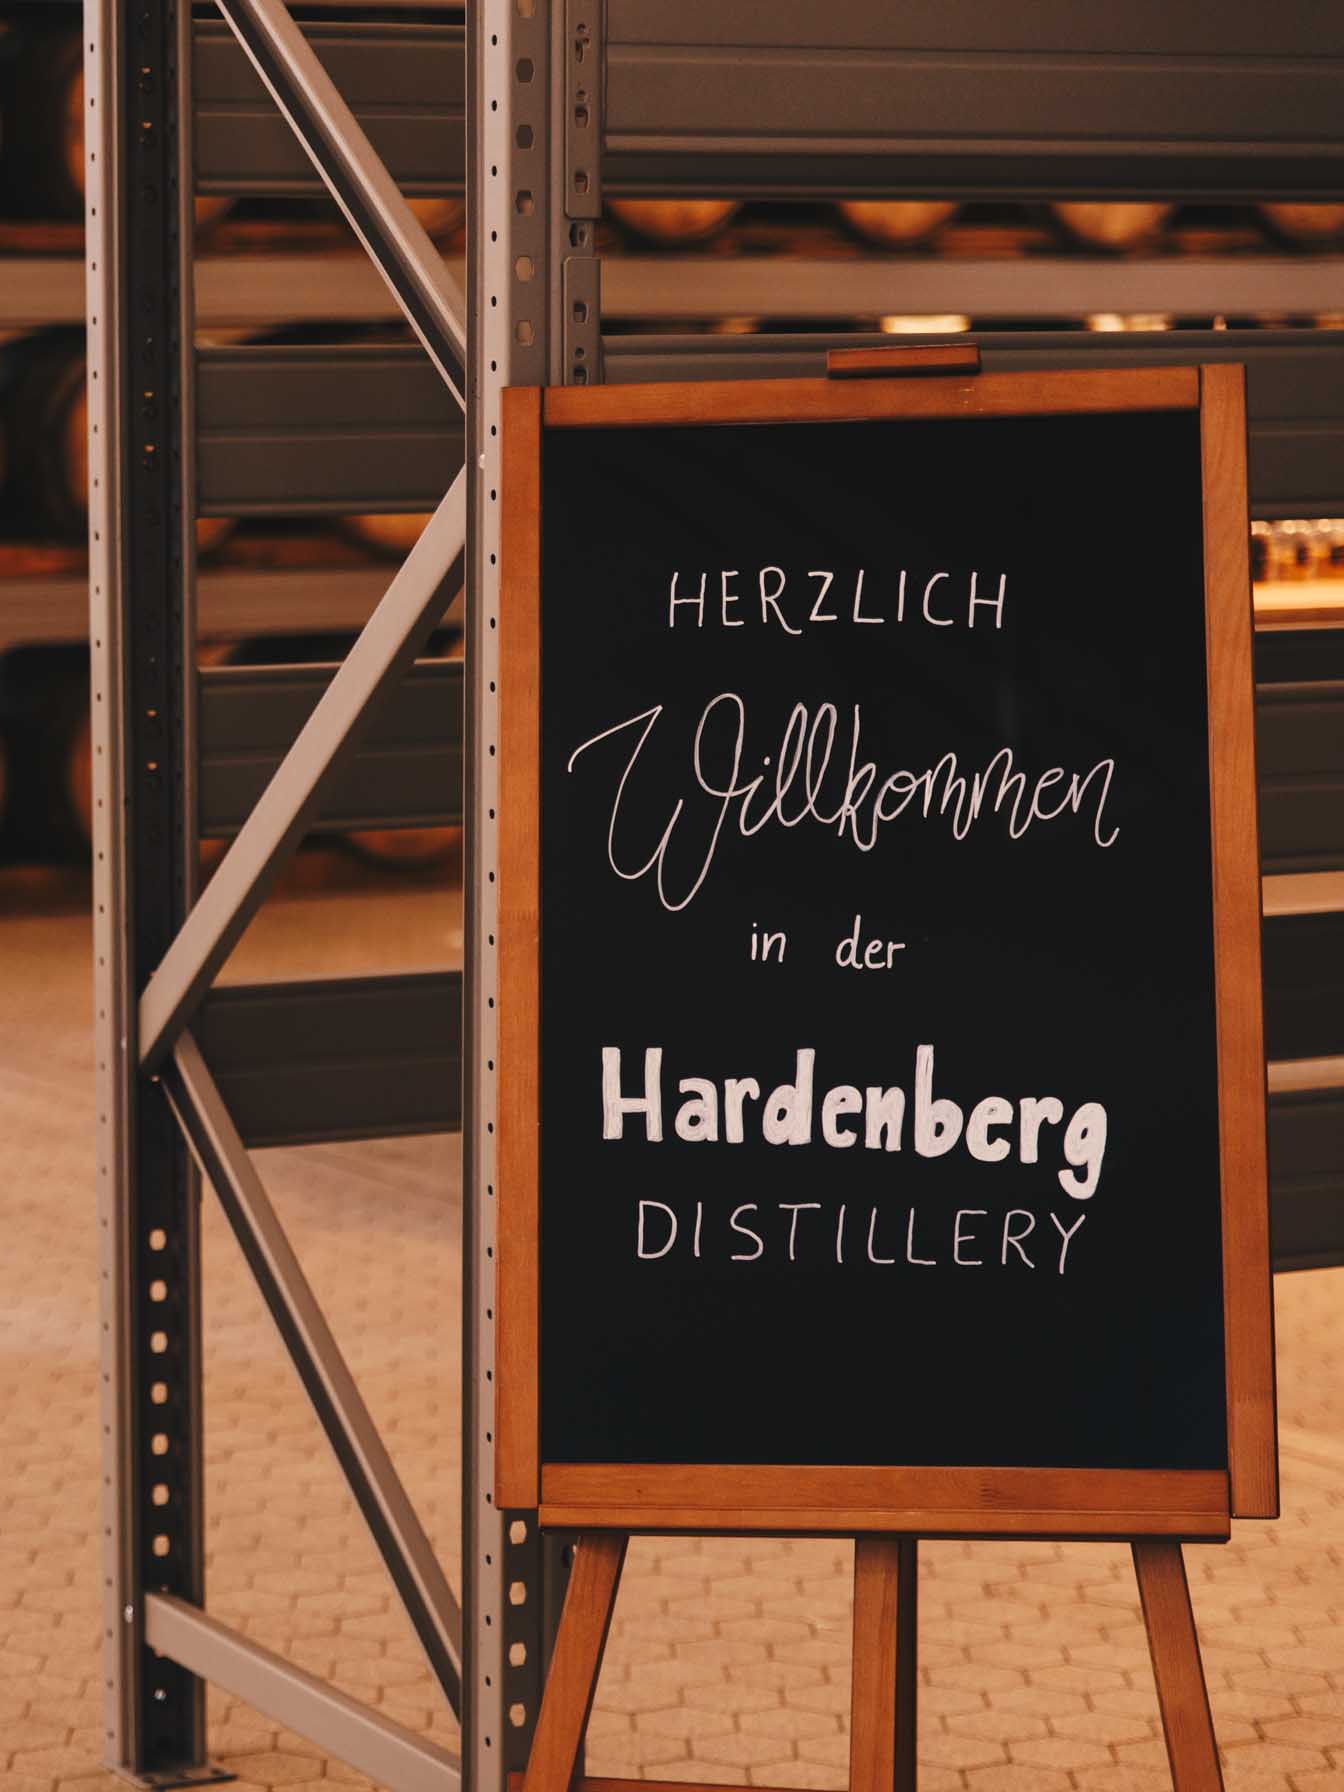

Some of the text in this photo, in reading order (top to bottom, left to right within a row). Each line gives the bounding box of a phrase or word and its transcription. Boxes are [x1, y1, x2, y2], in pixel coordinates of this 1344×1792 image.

[668, 566, 1008, 635] HERZLICH
[567, 692, 1121, 912] Willkommen
[750, 914, 906, 970] in der
[601, 1044, 1109, 1200] Hardenberg
[636, 1198, 1087, 1275] DISTILLERY
